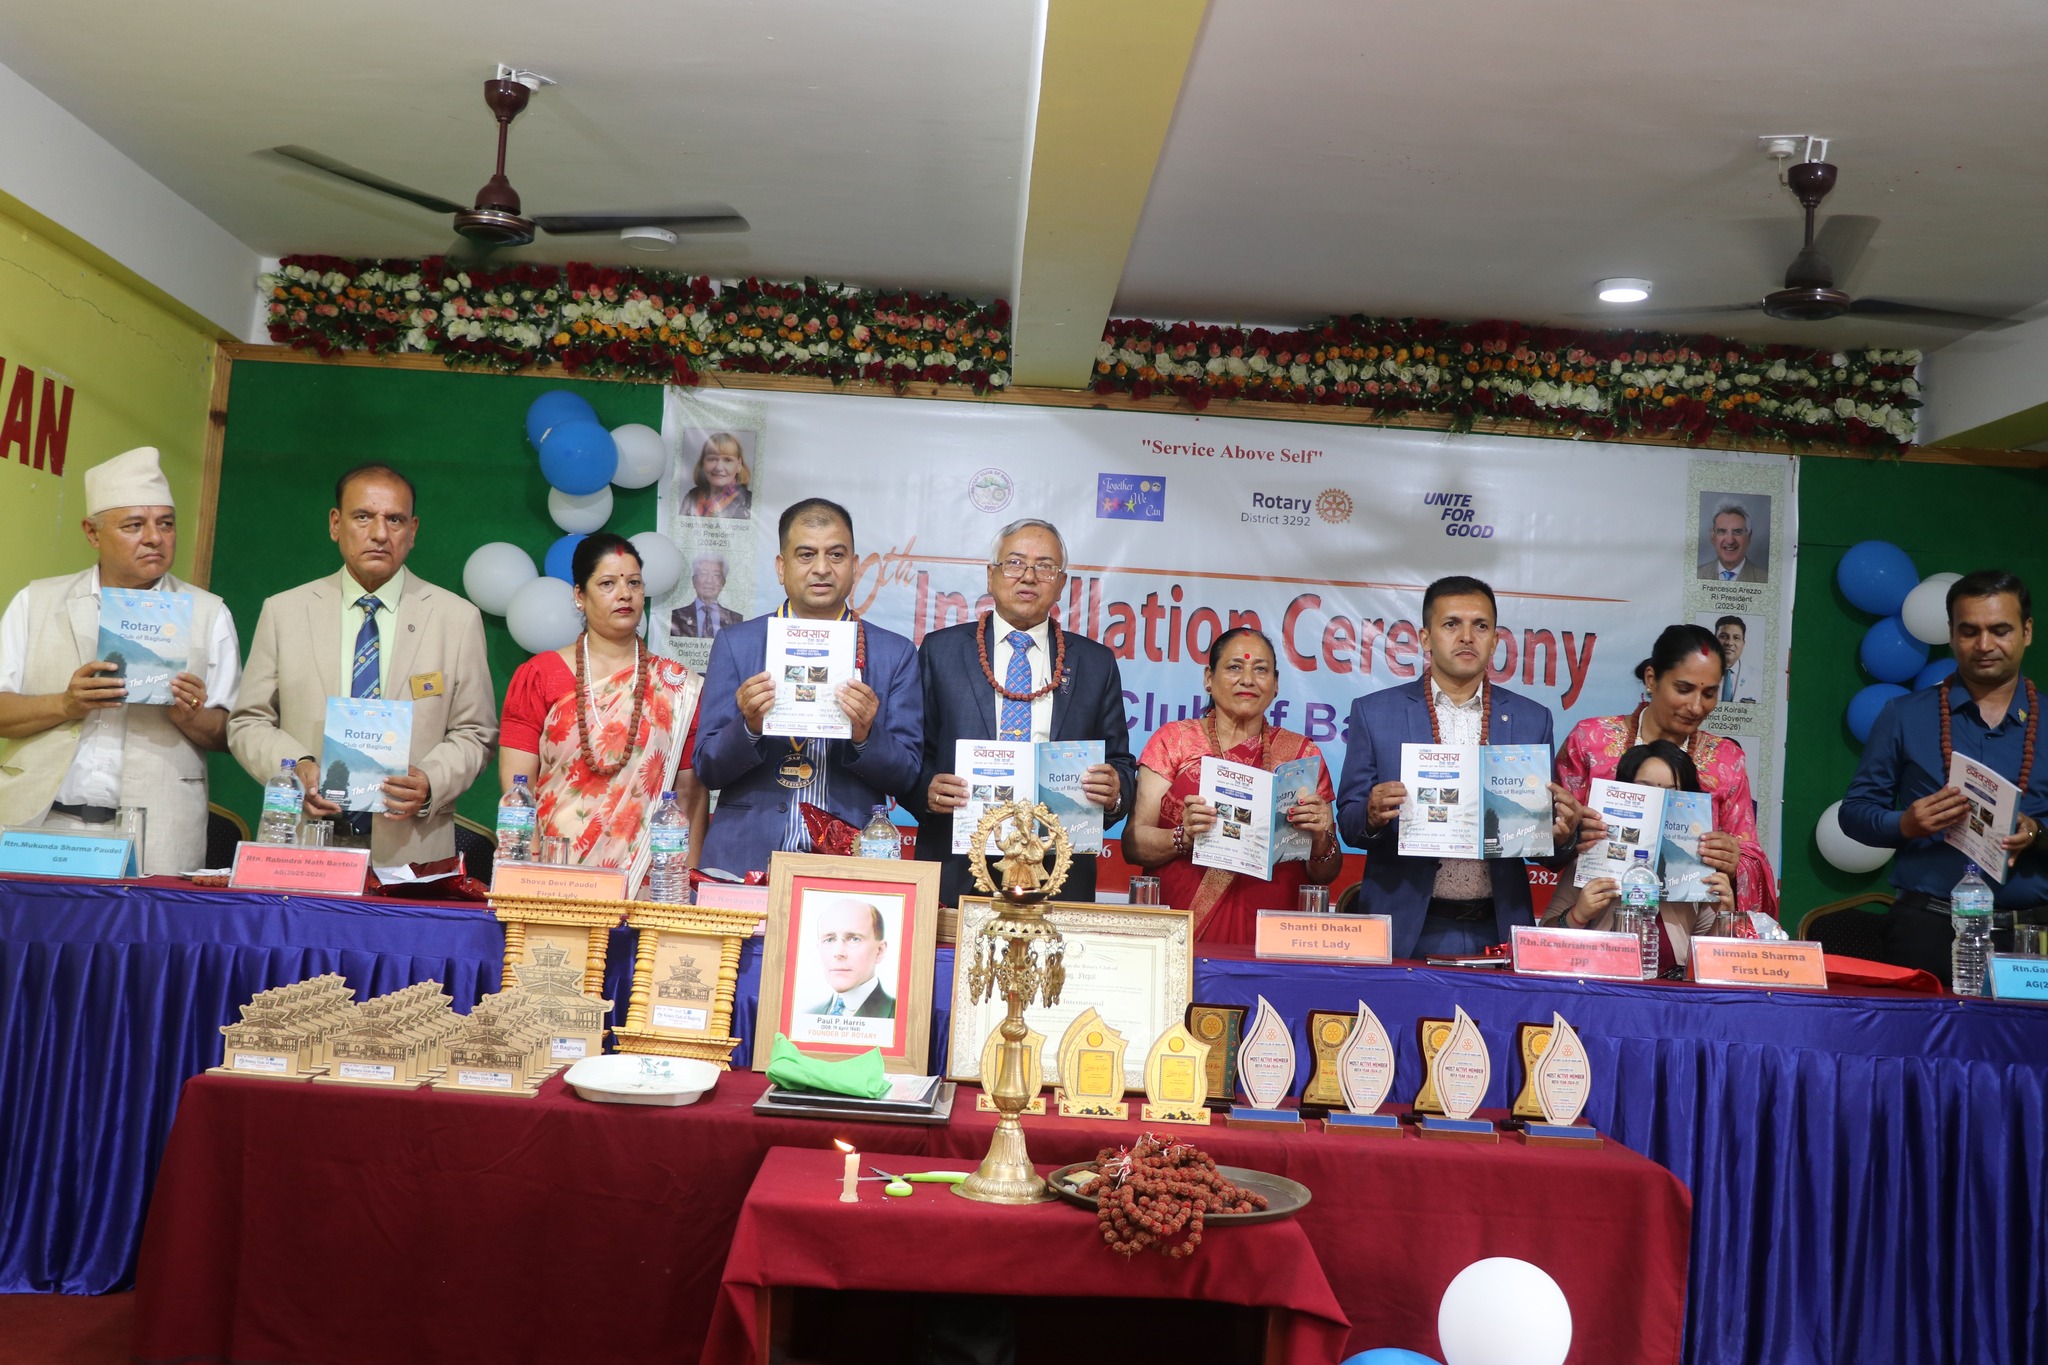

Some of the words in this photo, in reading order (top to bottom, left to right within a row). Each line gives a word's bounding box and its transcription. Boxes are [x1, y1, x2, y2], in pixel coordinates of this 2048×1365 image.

[0, 356, 75, 477] AN
[1141, 438, 1215, 457] "Service
[1220, 445, 1275, 462] Above
[1280, 448, 1323, 464] Self"
[1102, 478, 1134, 493] Together
[1131, 492, 1147, 504] We
[1252, 492, 1312, 514] Rotary
[1423, 492, 1473, 507] UNITE
[1146, 504, 1161, 516] Can
[1441, 508, 1475, 522] FOR
[680, 521, 713, 529] Stephanie
[1241, 512, 1279, 525] District
[1282, 515, 1311, 527] 3292
[1445, 523, 1495, 539] GOOD
[697, 540, 730, 548] (2024-25)
[1702, 585, 1738, 594] Francesco
[1739, 587, 1762, 595] Arezzo
[1720, 594, 1753, 603] President
[1715, 603, 1748, 611] (2025-26)
[121, 620, 161, 634] Rotary
[668, 640, 699, 650] Rajendra
[678, 649, 701, 657] District
[1281, 593, 1597, 710] Cereony
[129, 679, 143, 688] The
[145, 673, 168, 685] Arpan
[1724, 706, 1748, 714] Koirala
[1722, 715, 1753, 723] Governor
[1708, 723, 1741, 731] (2025-26)
[344, 729, 383, 742] Rotary
[1049, 773, 1081, 784] Rotary
[1491, 776, 1525, 788] Rotary
[351, 787, 365, 796] The
[1511, 788, 1535, 796] Baglung
[1069, 820, 1089, 834] Arpan
[1664, 820, 1689, 833] Rotary
[1502, 833, 1515, 842] The
[1516, 825, 1536, 838] Arpan
[4, 840, 58, 850] Rtn.Mukunda
[60, 844, 92, 852] Sharma
[265, 856, 302, 864] Rabindra
[520, 877, 546, 886] Shova
[1668, 876, 1679, 887] The
[1681, 871, 1700, 883] Arpan
[1280, 922, 1318, 931] Shanti
[1321, 923, 1362, 933] Dhakal
[1291, 939, 1319, 948] First
[1322, 940, 1351, 950] Lady
[1600, 943, 1636, 953] Sharma
[1713, 949, 1758, 959] Nirmala
[1761, 951, 1806, 961] Sharma
[1570, 957, 1589, 967] IPP
[1732, 966, 1758, 975] First
[1762, 967, 1790, 978] Lady
[808, 1029, 839, 1037] FOUNDER
[851, 1031, 877, 1039] ROTARY
